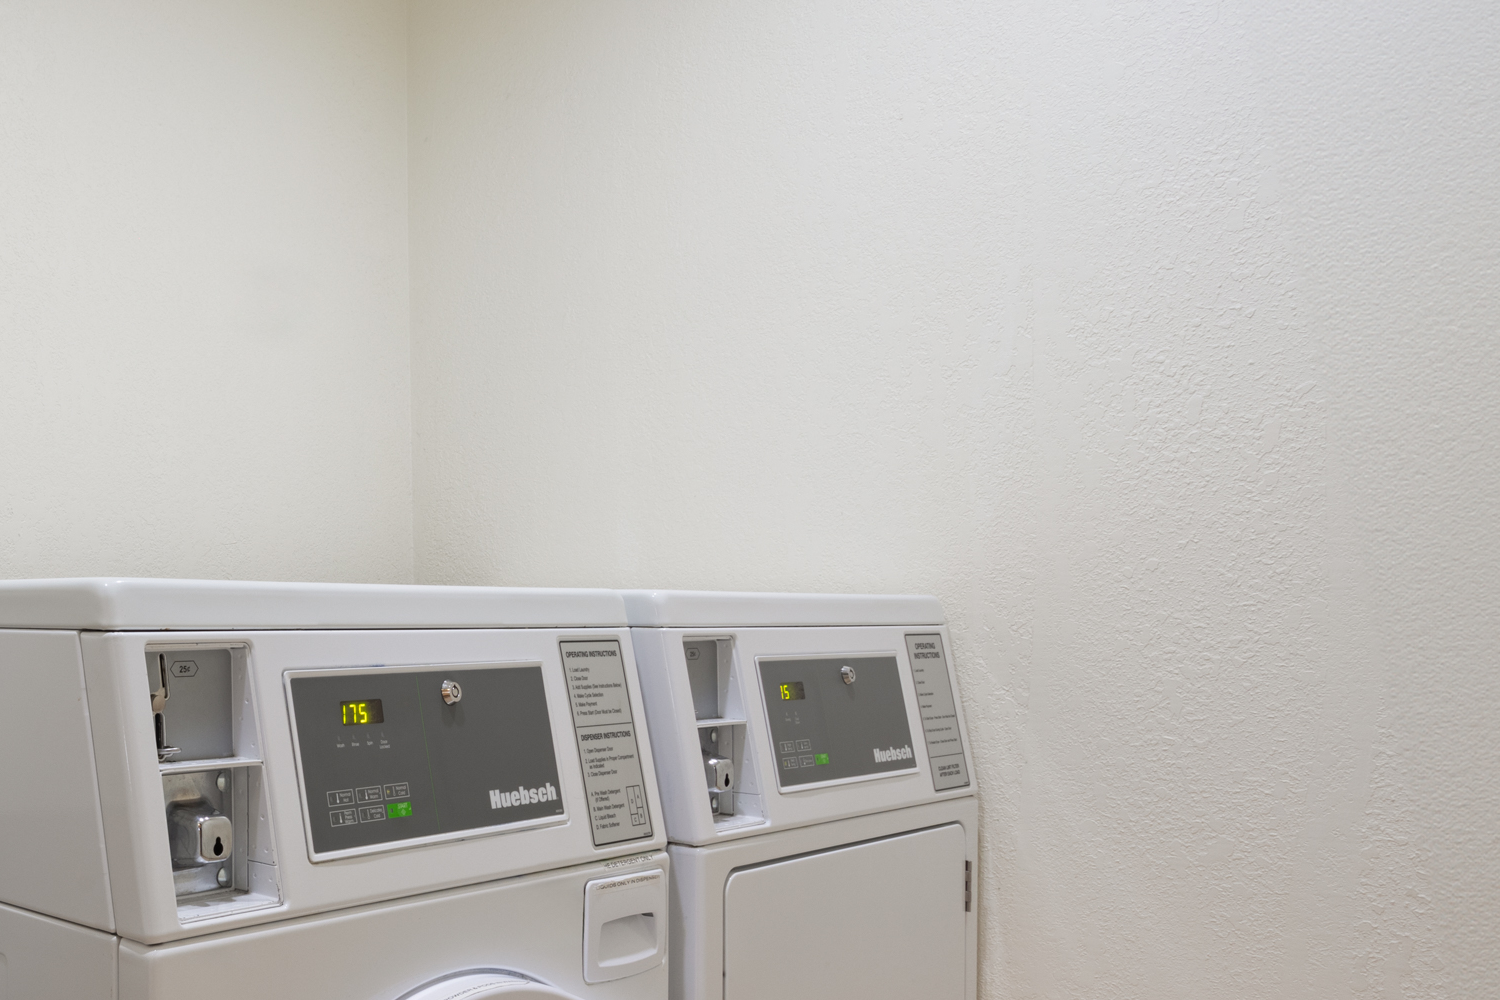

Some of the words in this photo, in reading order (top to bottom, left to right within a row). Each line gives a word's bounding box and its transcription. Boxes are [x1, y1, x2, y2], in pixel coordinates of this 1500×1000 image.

[780, 685, 790, 699] 15
[343, 703, 367, 724] 175
[581, 733, 603, 741] DISPENSER
[603, 730, 631, 739] INSTRUCTIONS
[873, 744, 912, 763] Huebsch
[489, 782, 557, 809] Huebsch
